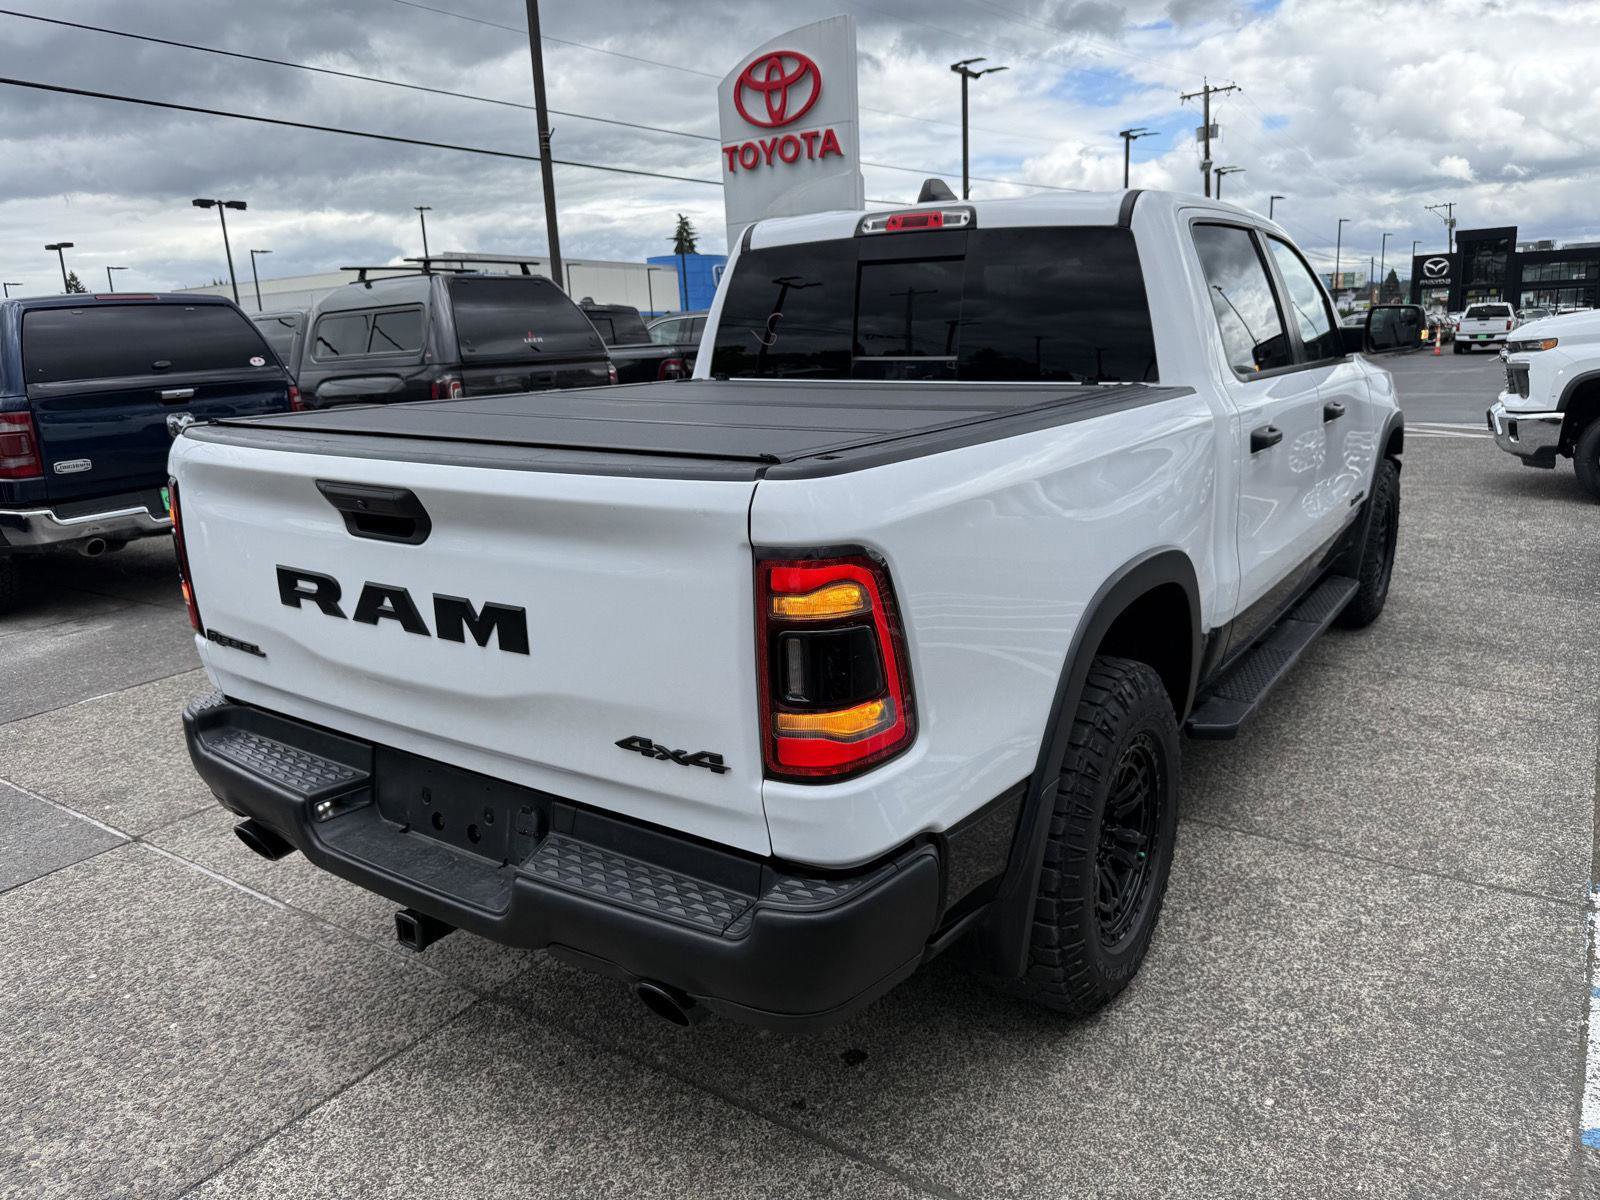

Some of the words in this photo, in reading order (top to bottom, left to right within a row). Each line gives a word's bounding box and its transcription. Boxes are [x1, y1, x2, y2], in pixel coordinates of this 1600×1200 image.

[722, 127, 845, 173] TOYOTA
[275, 563, 531, 656] RAM
[206, 628, 267, 658] REBEL
